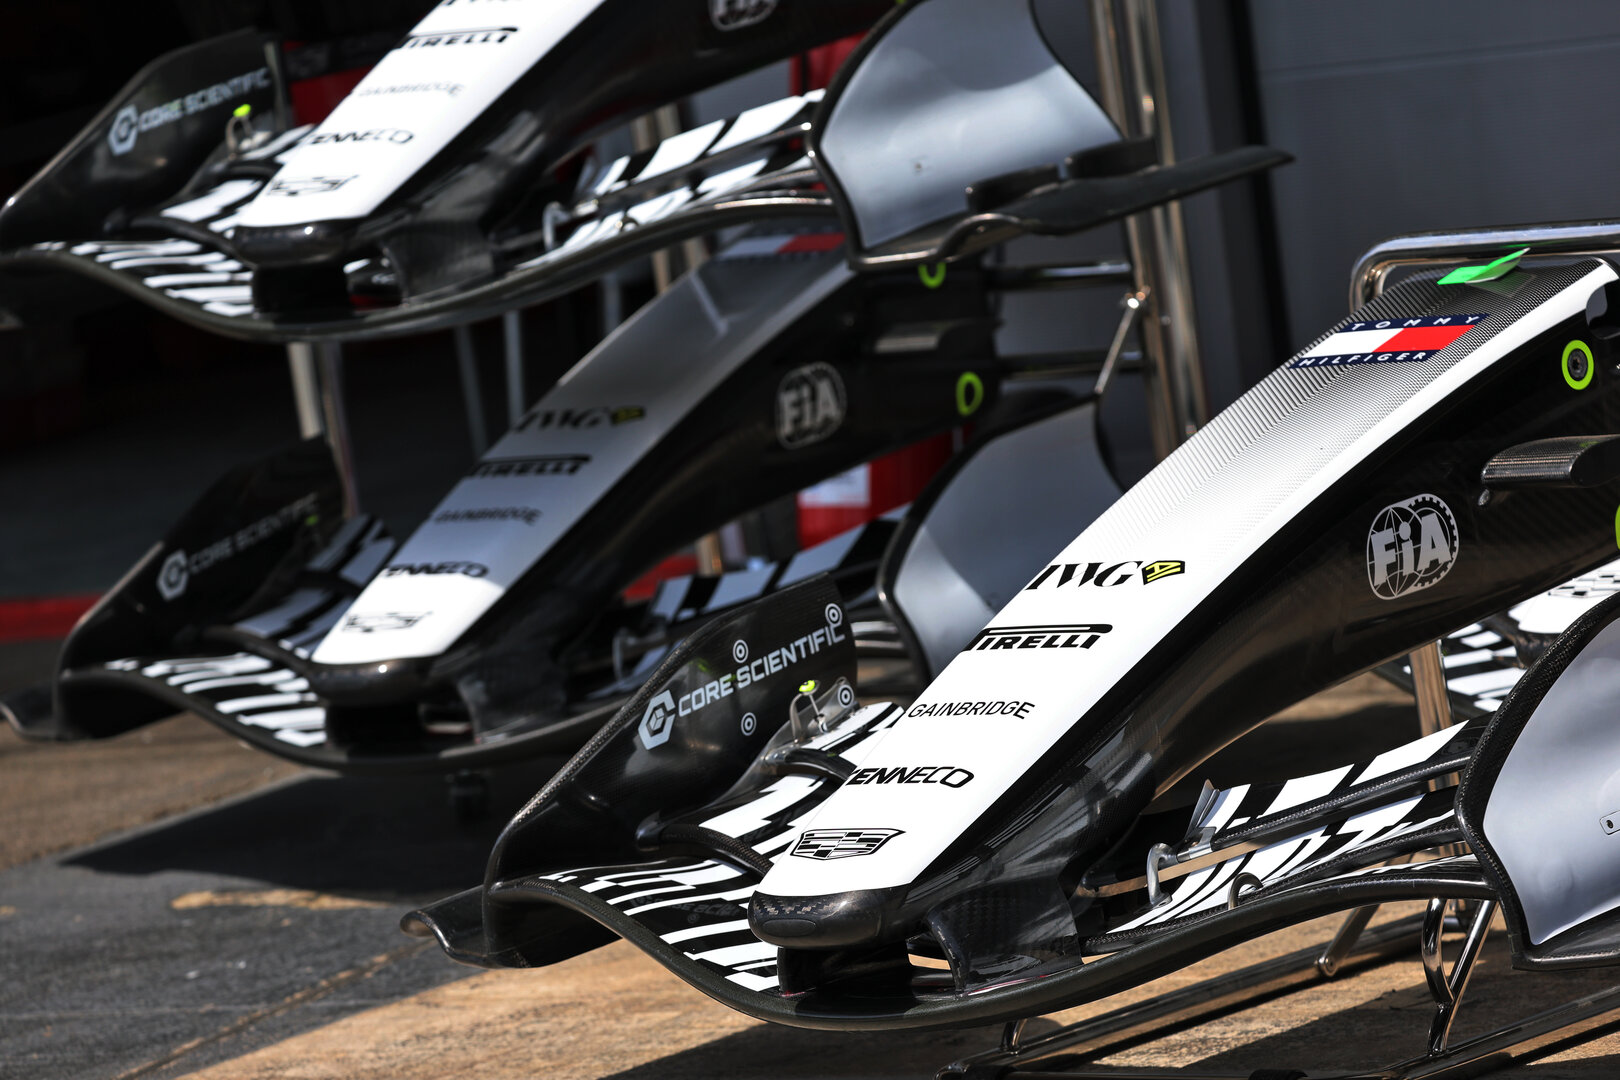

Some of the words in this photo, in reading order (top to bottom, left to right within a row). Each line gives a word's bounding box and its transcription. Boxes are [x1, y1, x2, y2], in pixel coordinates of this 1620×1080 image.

[138, 98, 183, 133] CORE
[184, 67, 272, 115] SCIENTIFIC
[1351, 315, 1480, 331] TOMMY
[1299, 351, 1428, 367] HILFIGER
[678, 673, 735, 718] CORE
[736, 624, 846, 689] SCIENTIFIC
[908, 701, 1036, 720] GAINBRIDGE
